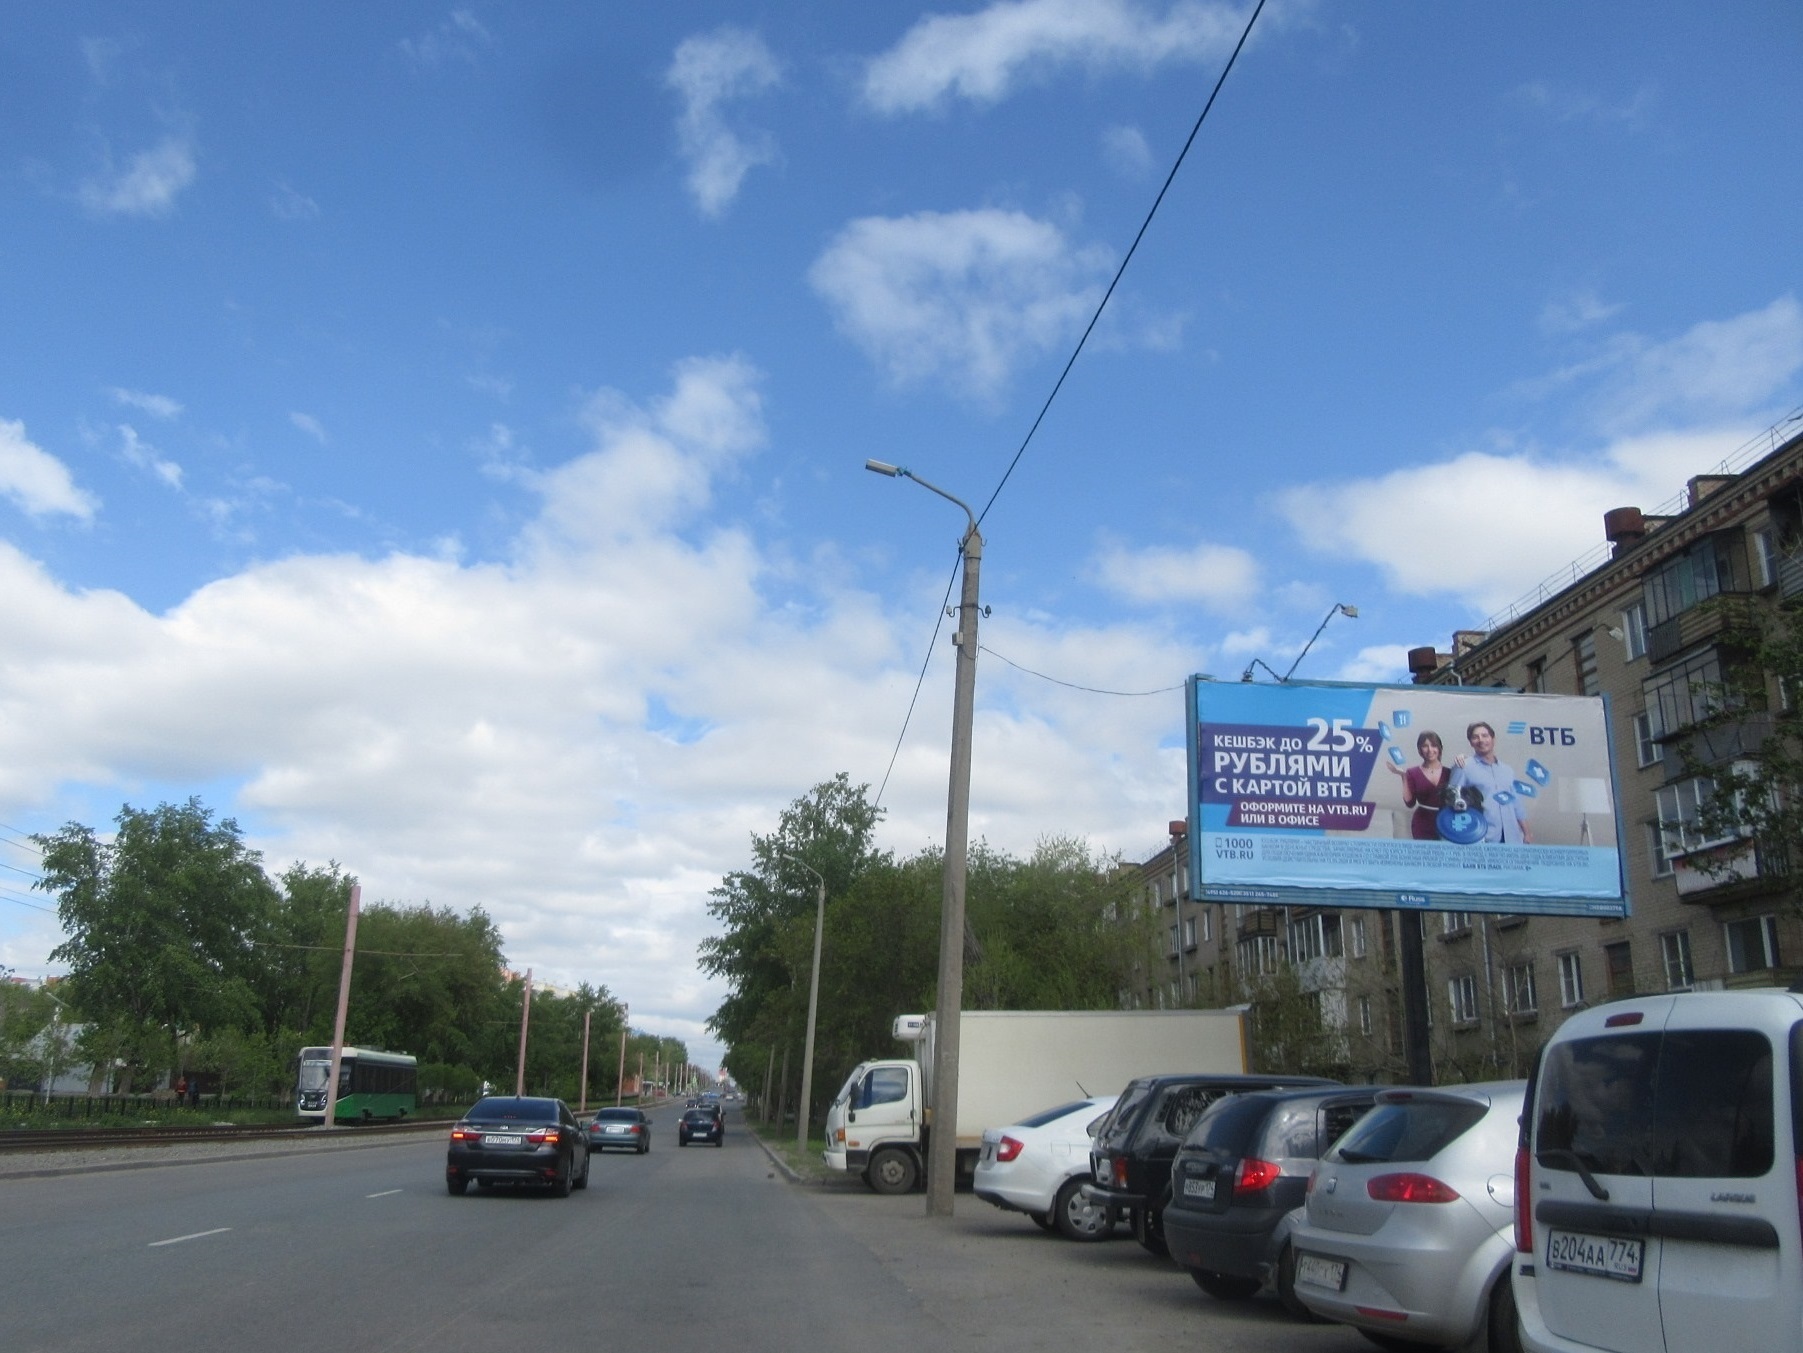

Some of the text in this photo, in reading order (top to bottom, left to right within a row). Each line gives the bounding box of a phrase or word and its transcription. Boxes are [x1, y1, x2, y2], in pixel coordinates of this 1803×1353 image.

[1214, 717, 1374, 753] КЕШБЭК ДО 25%
[1529, 726, 1576, 746] ВТБ
[1214, 751, 1351, 778] РУБЛЯМИ
[1215, 777, 1353, 798] С КАРТОЙ ВТБ
[1240, 801, 1368, 816] ОФОРМИТЕ НА VTB.RU
[1240, 813, 1320, 826] ИЛИ В ОФИСЕ
[1225, 838, 1254, 850] 1000
[1216, 849, 1254, 860] VTB.RU
[1609, 1238, 1636, 1264] 774
